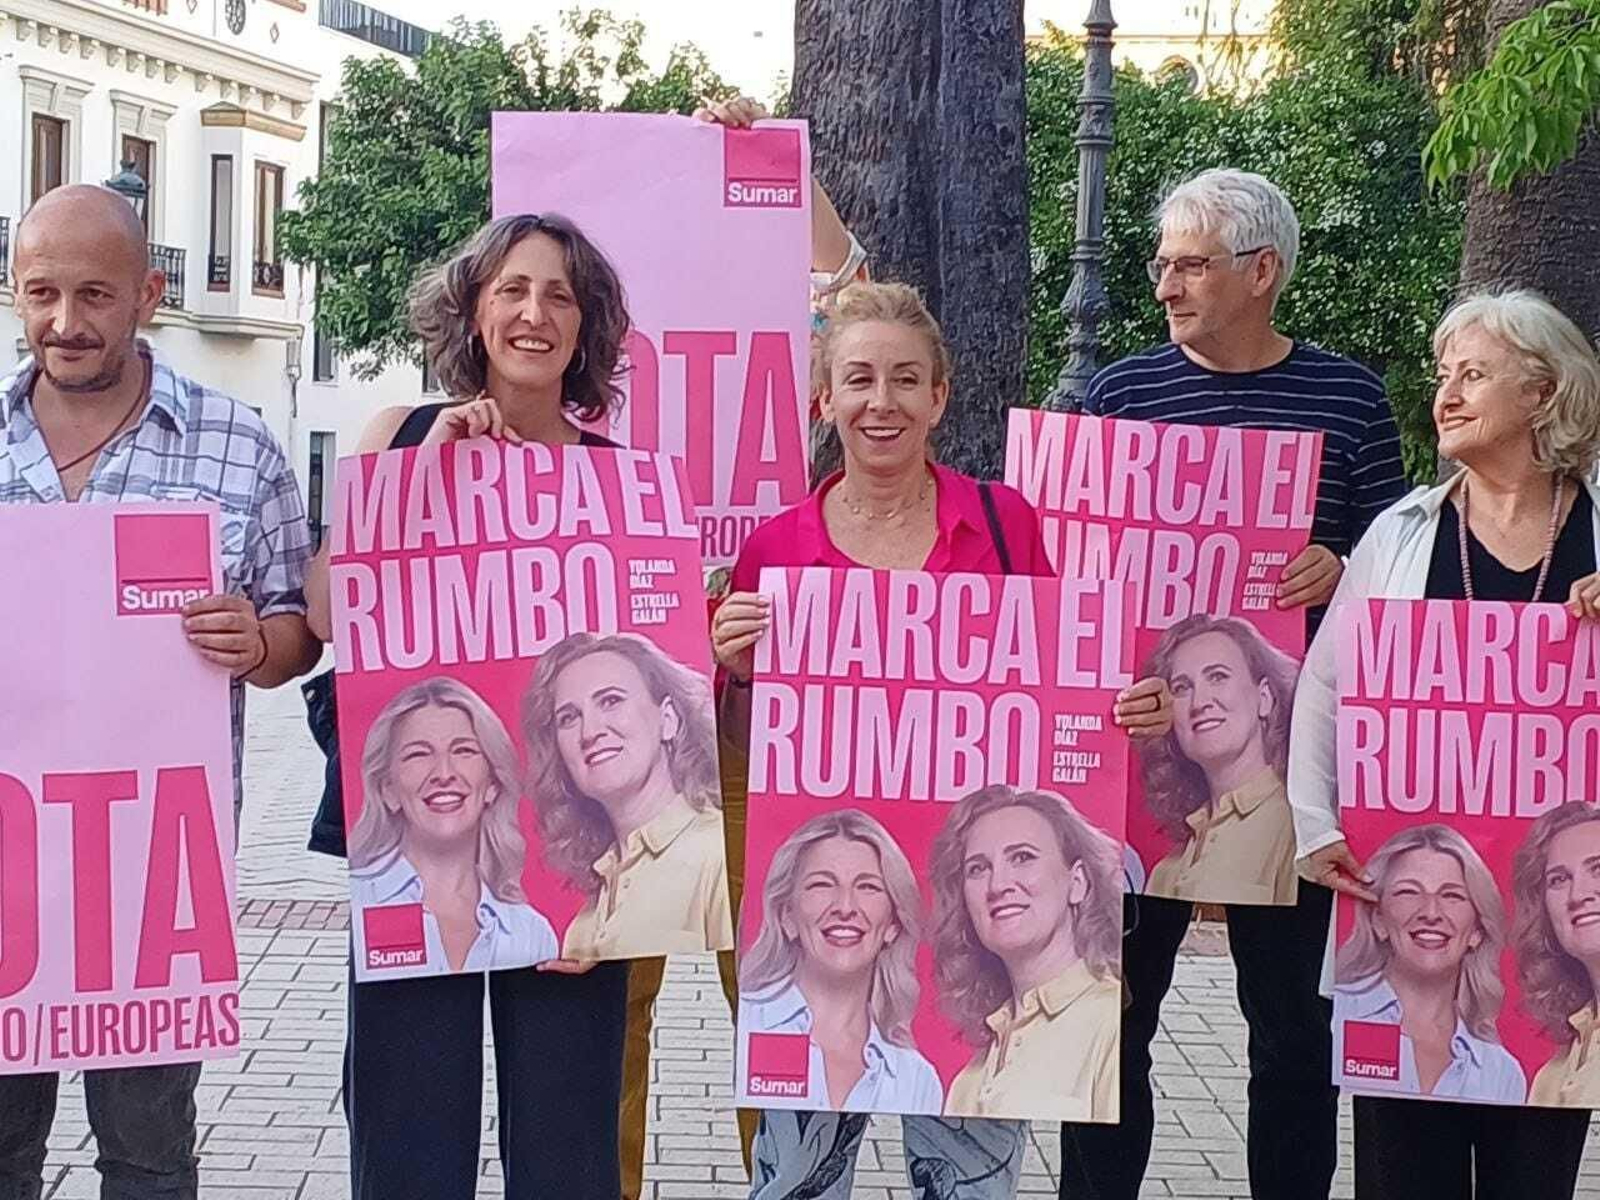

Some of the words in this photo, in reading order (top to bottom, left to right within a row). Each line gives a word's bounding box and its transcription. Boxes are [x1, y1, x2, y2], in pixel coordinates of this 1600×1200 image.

[728, 181, 799, 203] Sumar
[330, 437, 611, 555] MARCA
[615, 448, 700, 538] EL
[1004, 407, 1244, 526] MARCA
[1256, 430, 1319, 530] EL
[330, 541, 618, 674] RUMBO
[753, 565, 1041, 686] MARCA
[1056, 578, 1134, 689] EL
[747, 682, 1041, 803] RUMBO
[369, 949, 423, 965] Sumar
[750, 1076, 805, 1094] Sumar
[1345, 1059, 1397, 1077] Sumar
